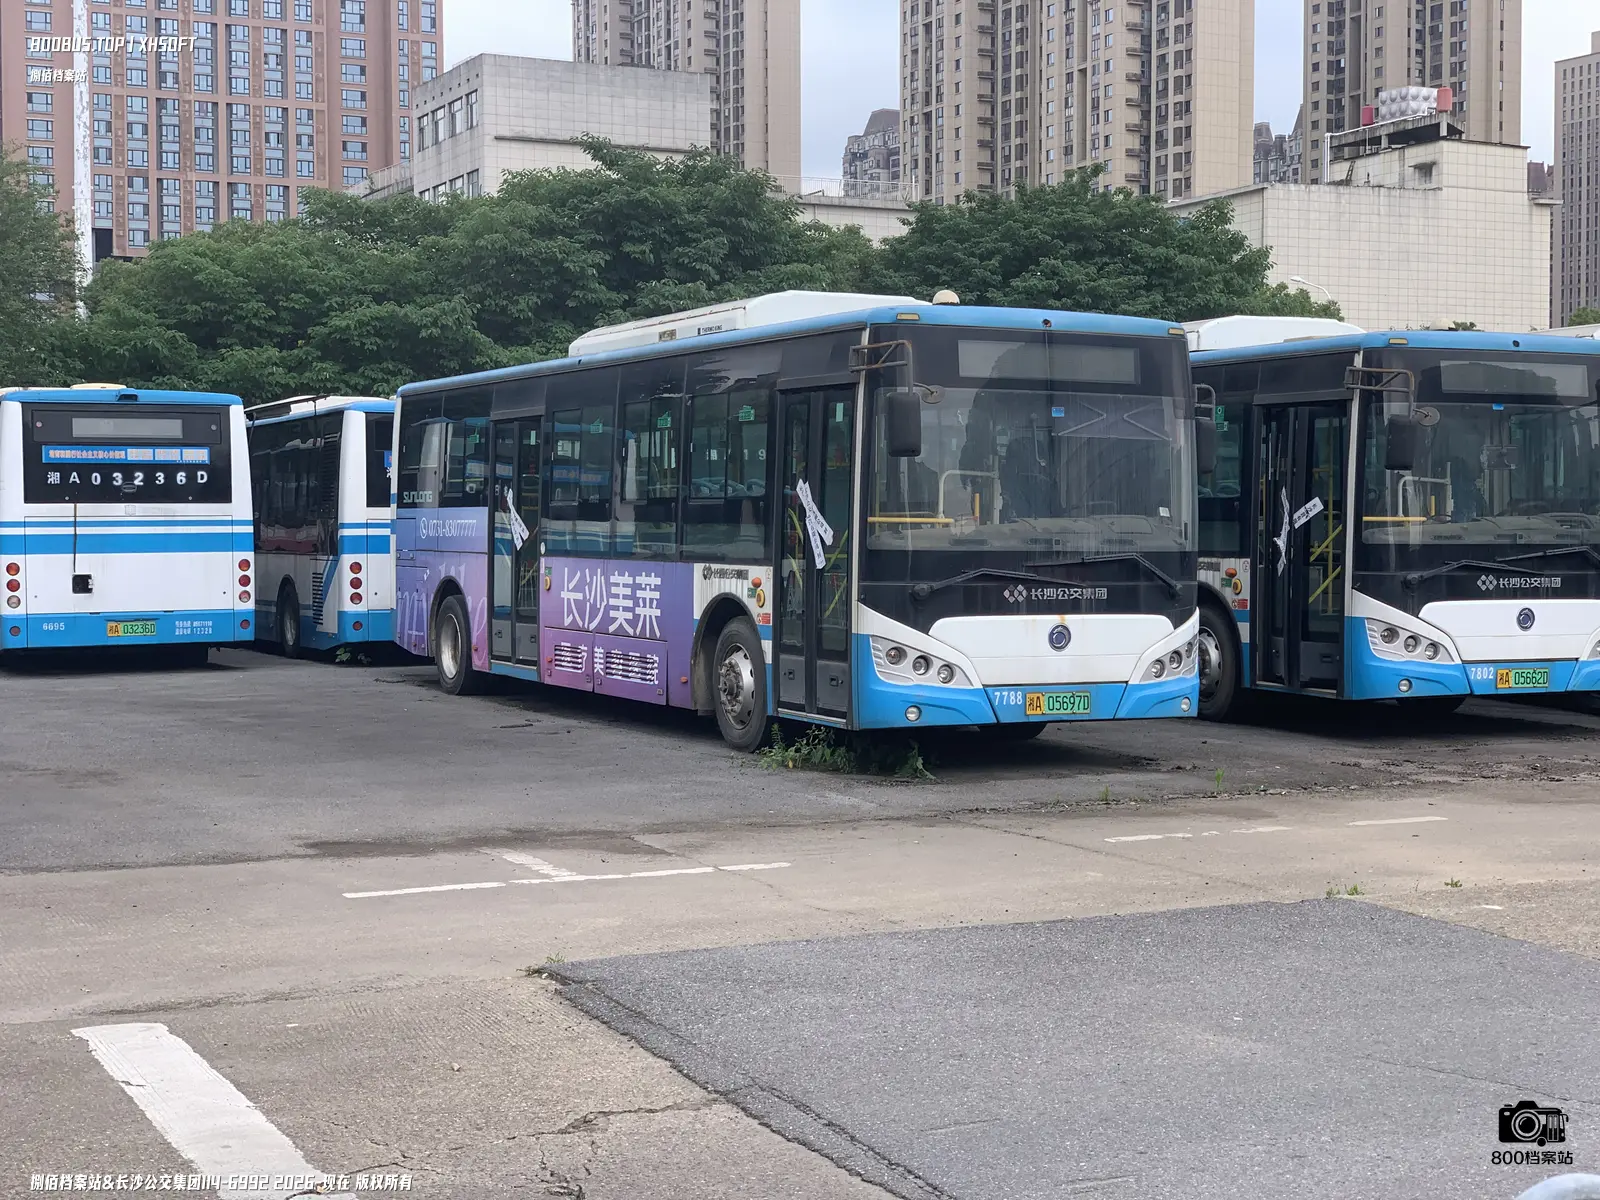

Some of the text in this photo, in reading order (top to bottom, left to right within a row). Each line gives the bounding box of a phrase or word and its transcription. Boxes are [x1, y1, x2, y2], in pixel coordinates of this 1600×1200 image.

[1499, 577, 1562, 588] 长沙公交集团
[1030, 587, 1108, 600] 长沙公交集团
[560, 567, 661, 639] 长沙美莱
[42, 622, 65, 631] 6695
[1470, 666, 1494, 679] 7802
[994, 691, 1023, 705] 7788
